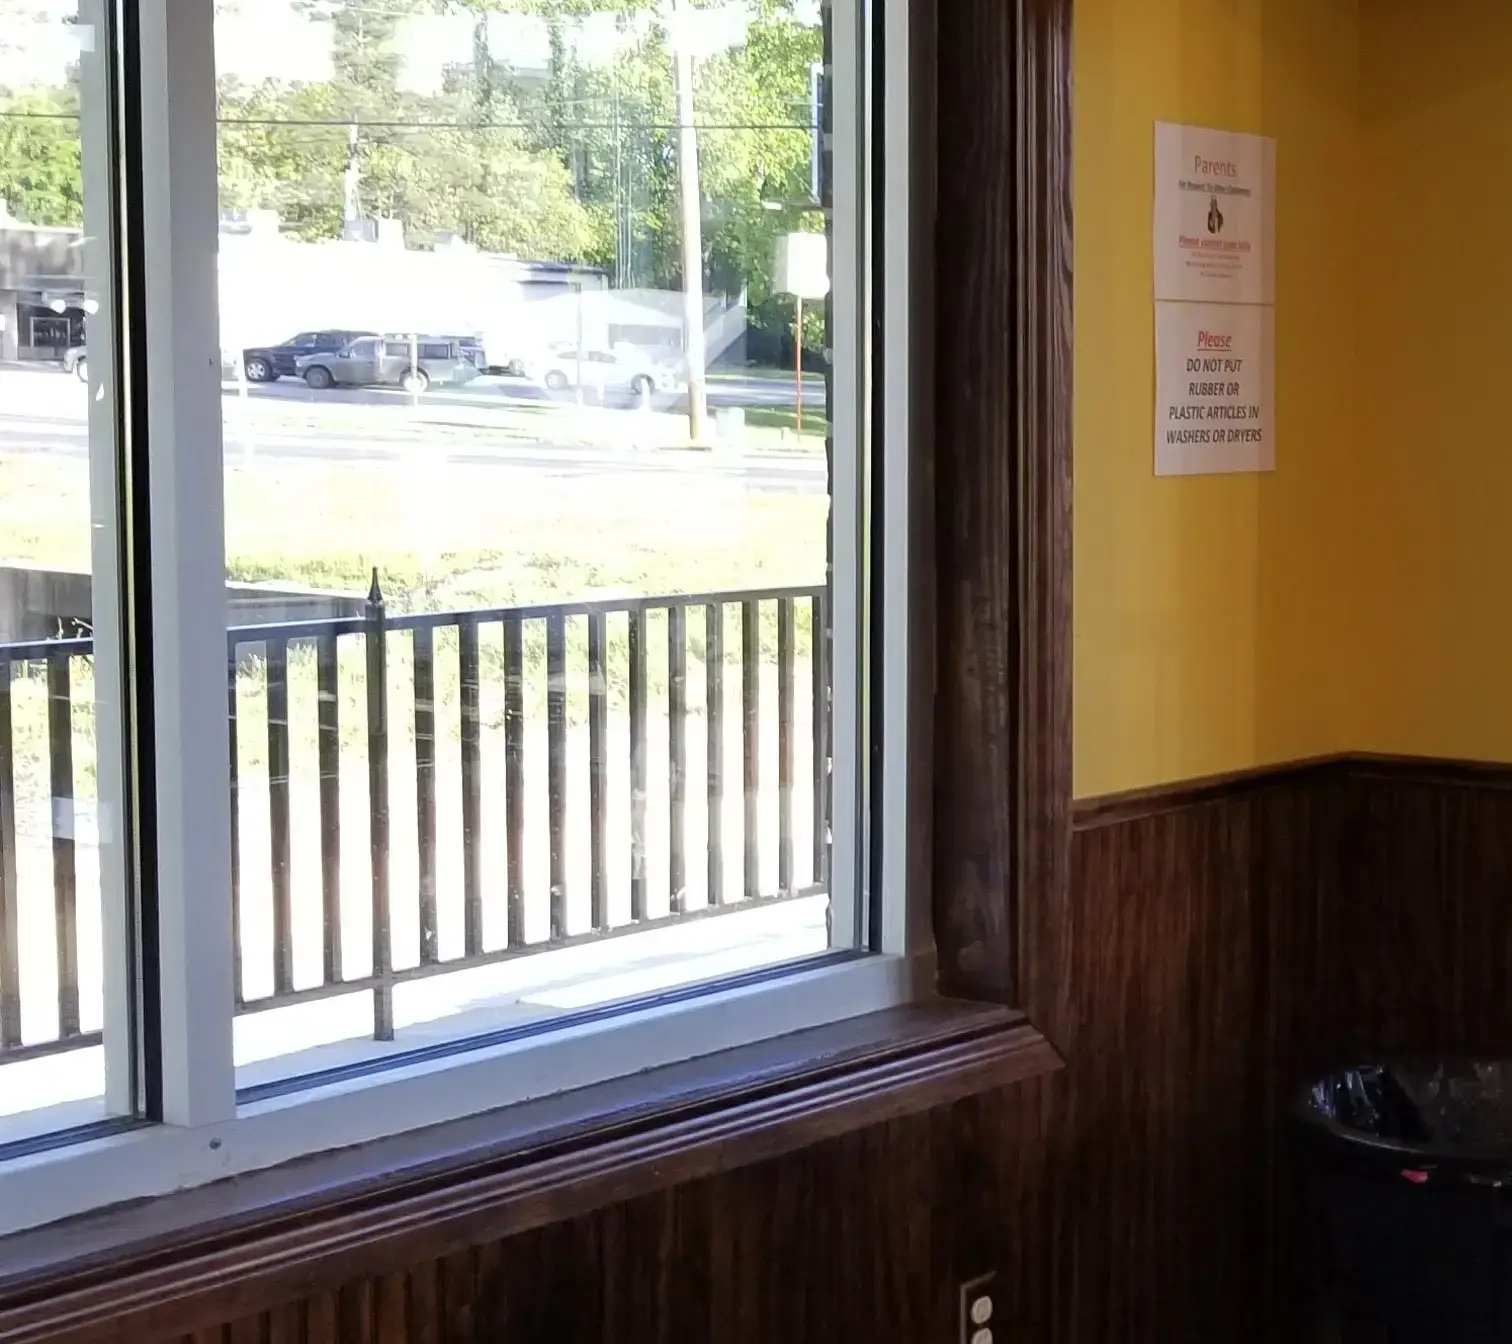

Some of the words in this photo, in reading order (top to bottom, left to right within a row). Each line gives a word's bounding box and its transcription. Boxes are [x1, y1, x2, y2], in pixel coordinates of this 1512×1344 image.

[1194, 154, 1238, 178] Parents
[1197, 330, 1233, 349] Please
[1186, 357, 1201, 373] DO
[1202, 358, 1223, 373] NOT
[1224, 358, 1243, 373] PUT
[1188, 381, 1226, 397] RUBBER
[1226, 382, 1240, 397] OR
[1168, 406, 1205, 421] PLASTIC
[1206, 405, 1247, 420] ARTICLES
[1248, 405, 1260, 420] IN
[1166, 429, 1211, 444] WASHERS
[1212, 428, 1226, 443] OR
[1227, 428, 1263, 443] DRYERS
